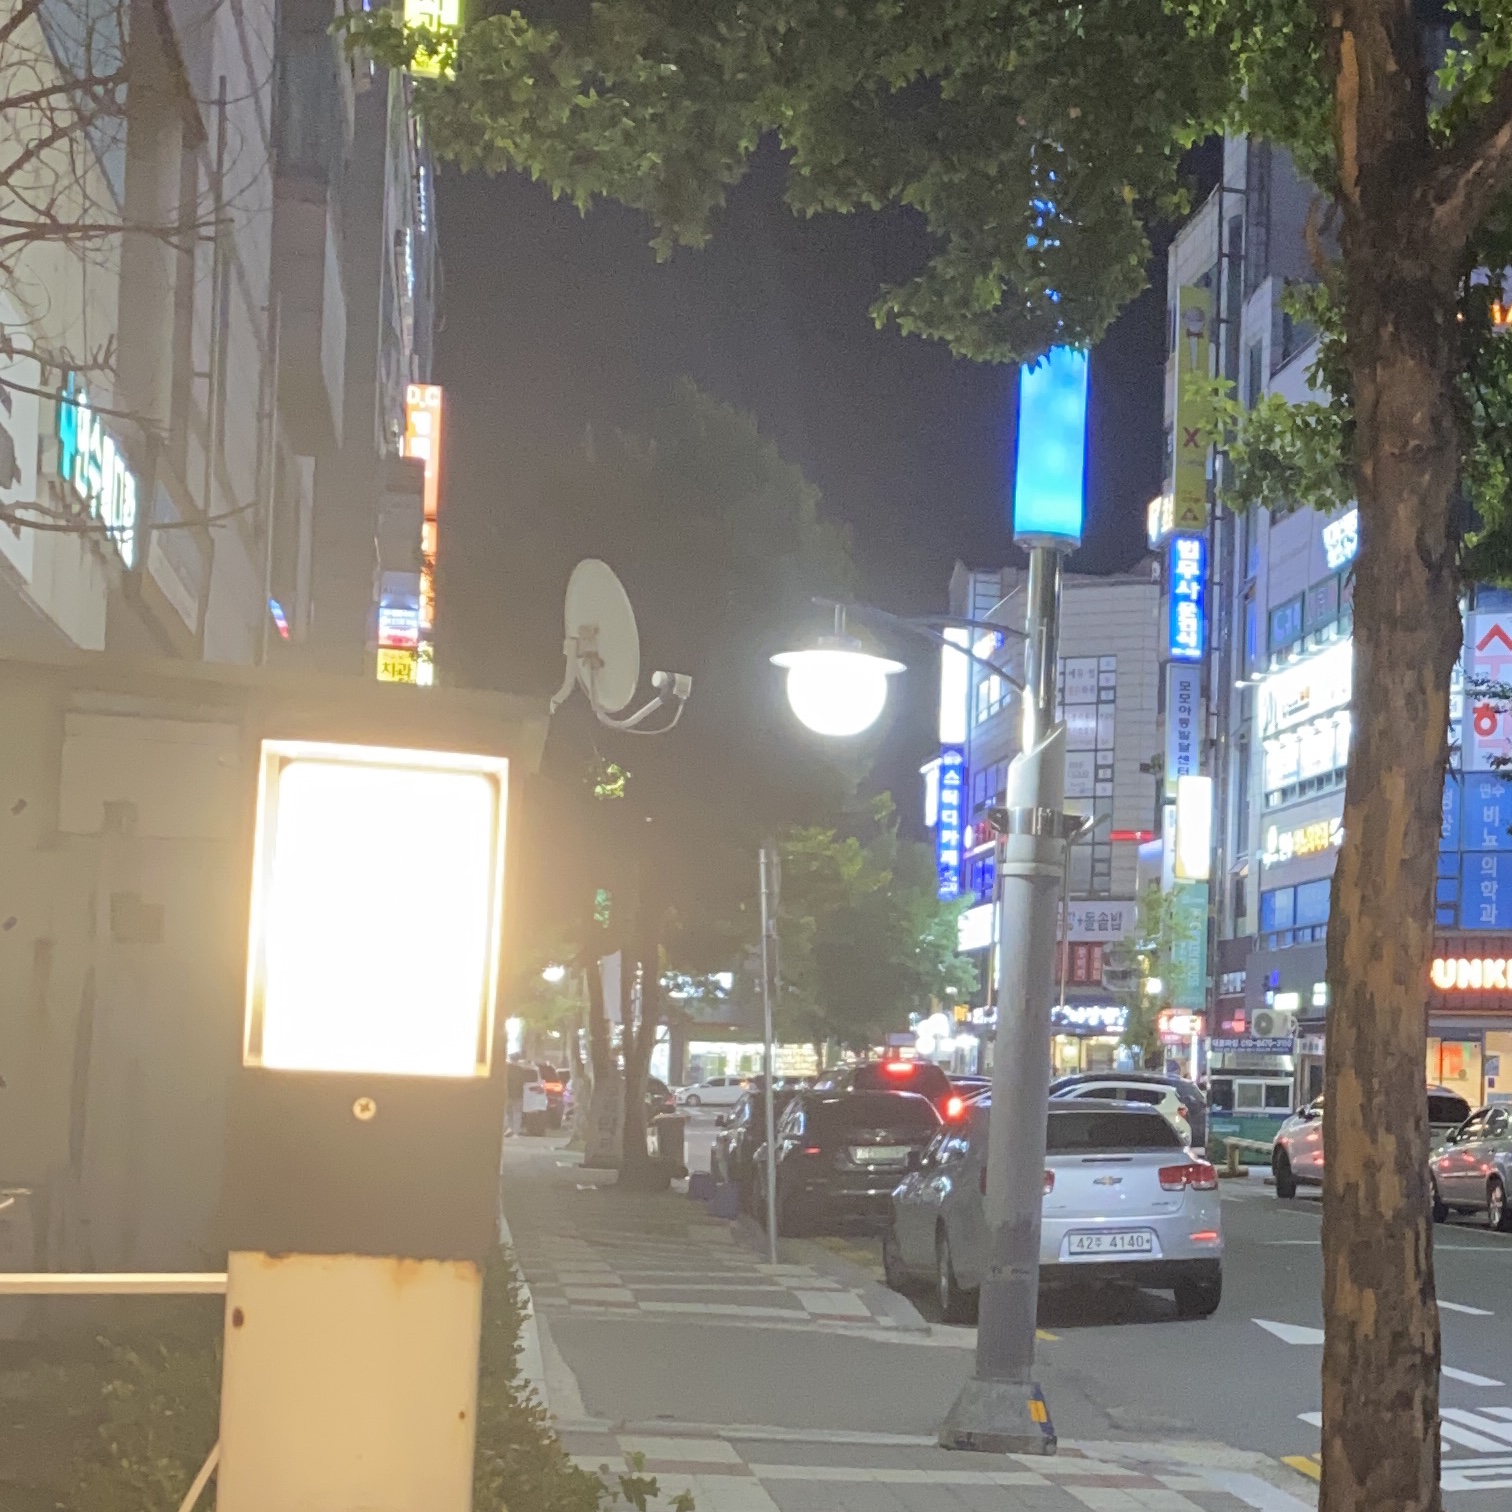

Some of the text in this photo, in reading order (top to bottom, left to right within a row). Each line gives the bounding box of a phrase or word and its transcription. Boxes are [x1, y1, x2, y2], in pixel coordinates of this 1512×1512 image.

[381, 661, 412, 679] 치과
[1479, 804, 1500, 925] 비뇨의학과
[1109, 1234, 1145, 1248] 4140
